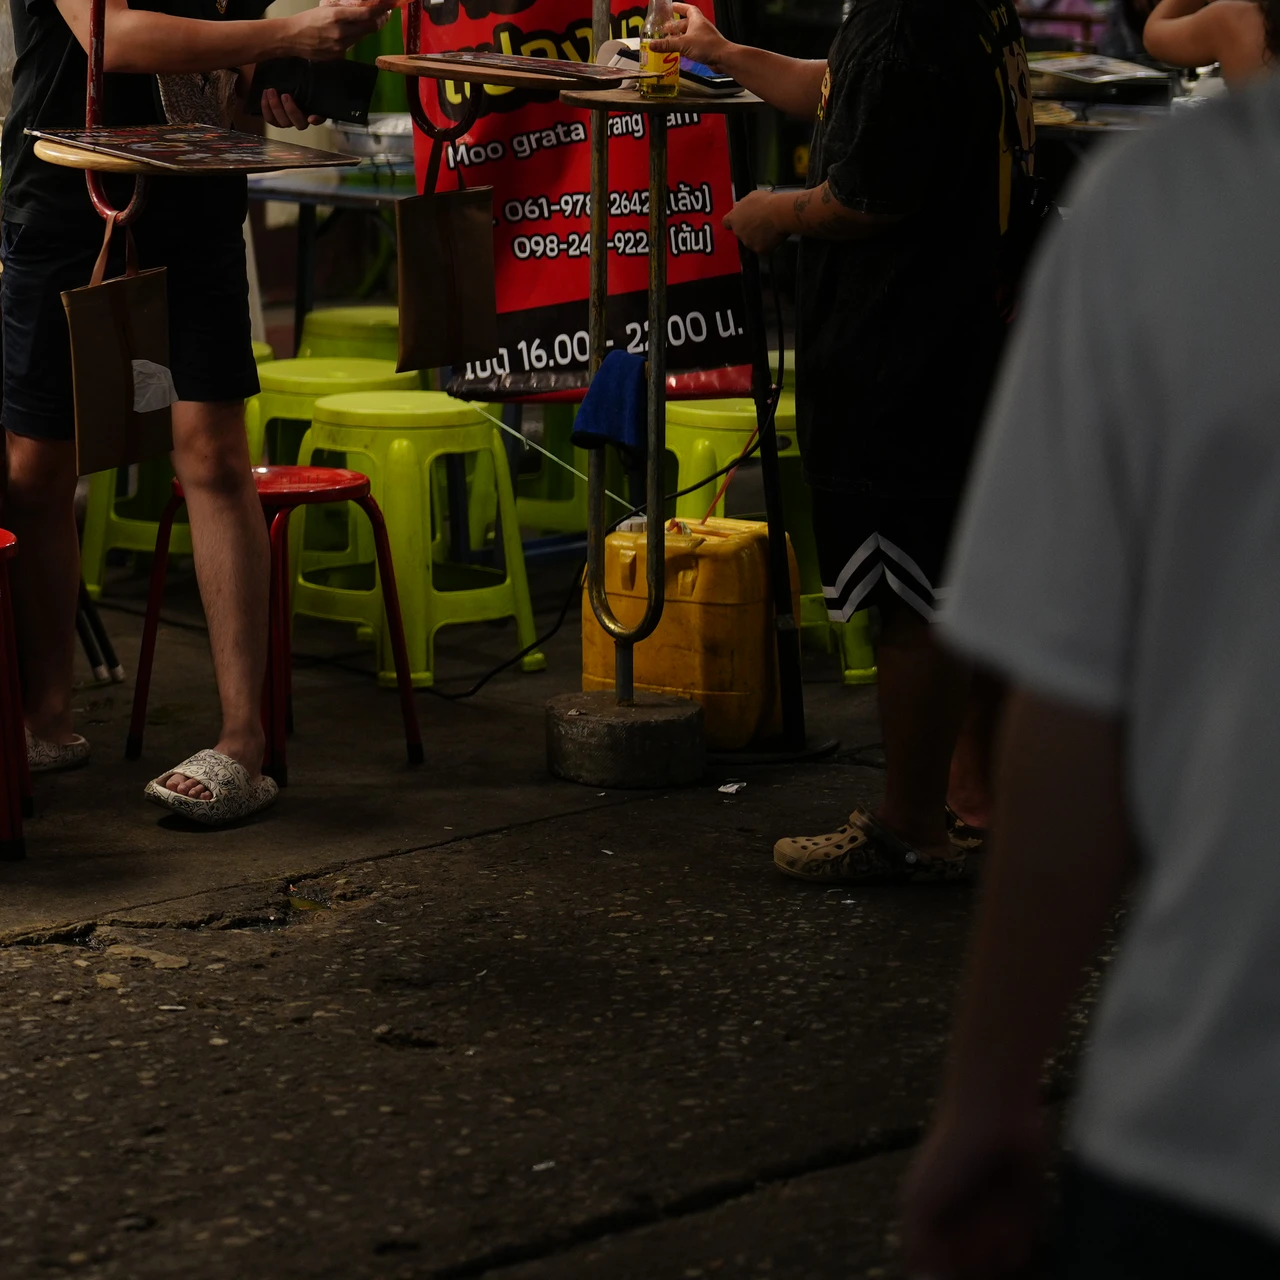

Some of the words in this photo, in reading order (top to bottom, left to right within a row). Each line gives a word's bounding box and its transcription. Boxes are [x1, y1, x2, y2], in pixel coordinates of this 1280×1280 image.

[447, 141, 503, 169] Moo
[513, 122, 586, 157] grata
[608, 113, 644, 138] rang
[504, 191, 650, 221] 061-972642
[513, 231, 649, 259] 098-24-922
[517, 330, 590, 371] 16.00
[625, 312, 707, 354] 200
